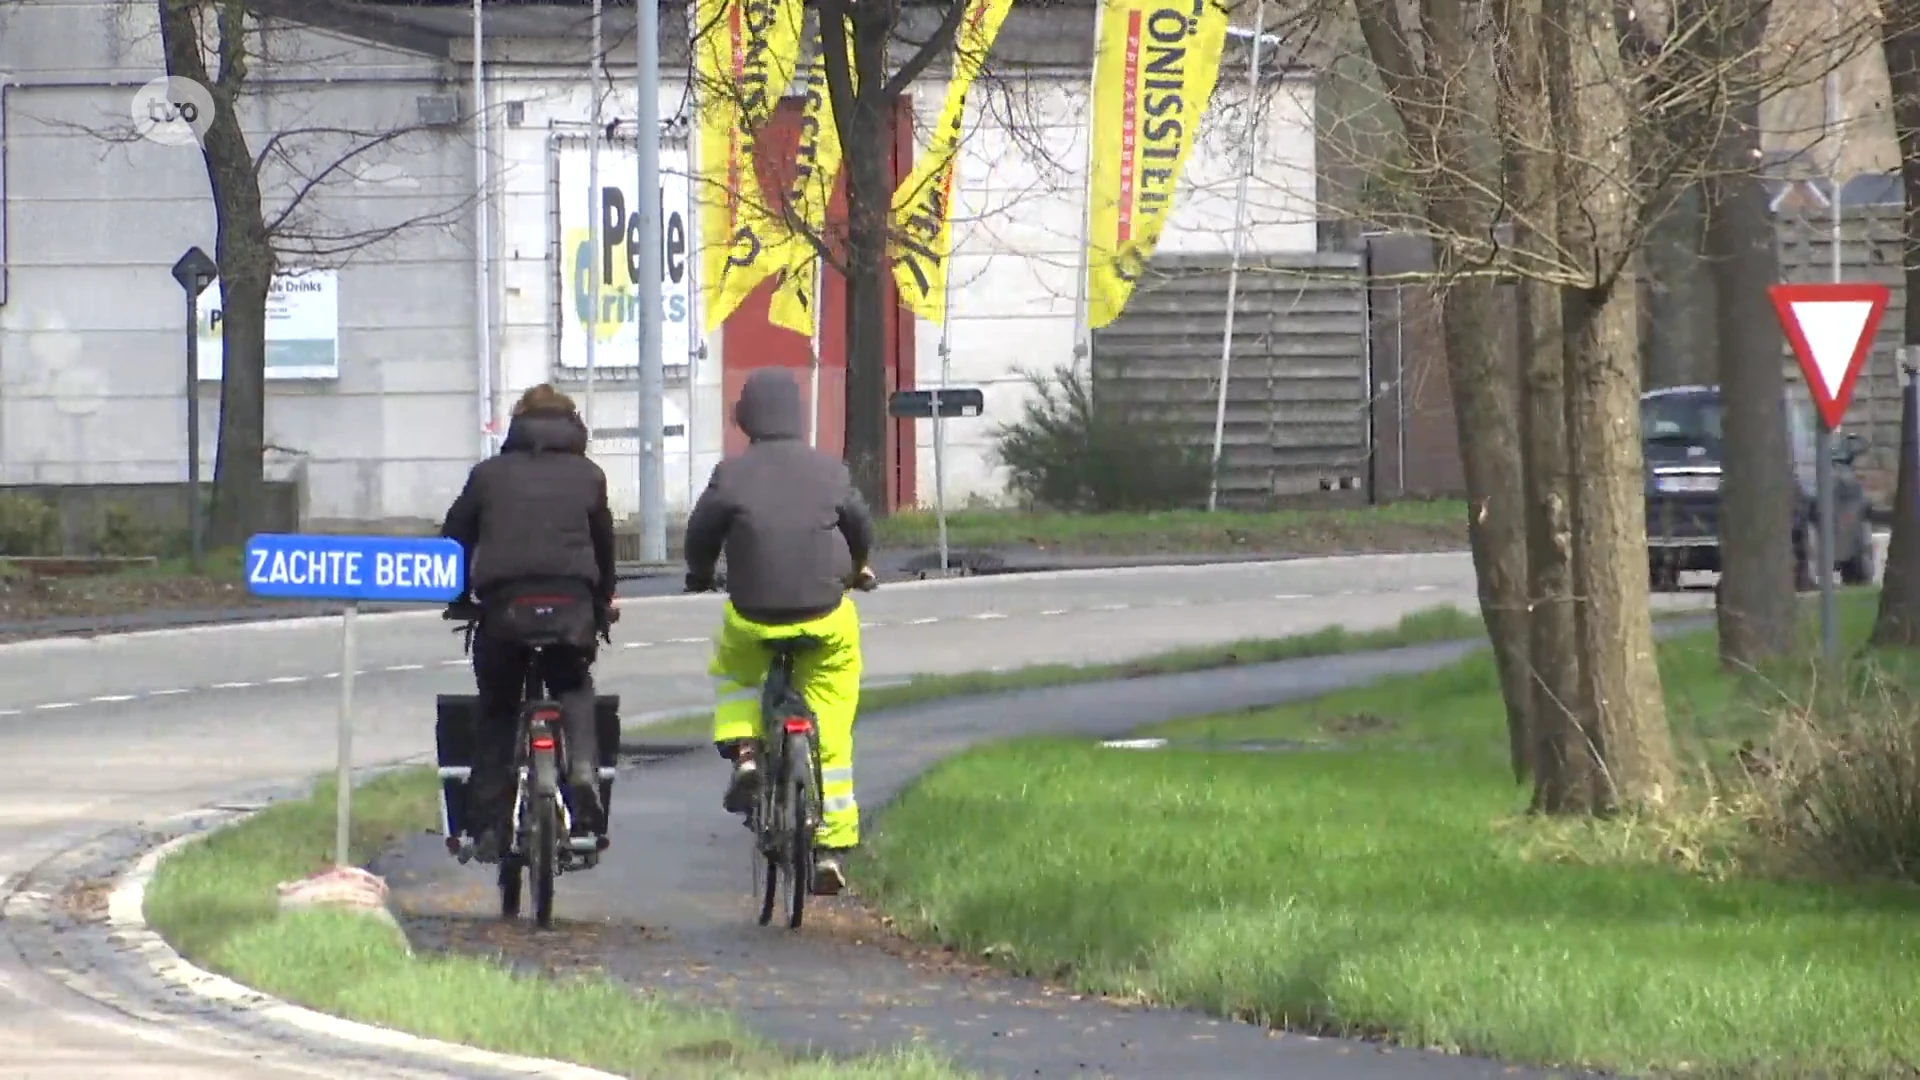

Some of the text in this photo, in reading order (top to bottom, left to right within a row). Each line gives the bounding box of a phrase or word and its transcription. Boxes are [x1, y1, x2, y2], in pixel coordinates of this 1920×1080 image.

[575, 187, 686, 323] drins
[285, 280, 322, 292] Drinks
[250, 549, 457, 588] ZACHTE BERM
